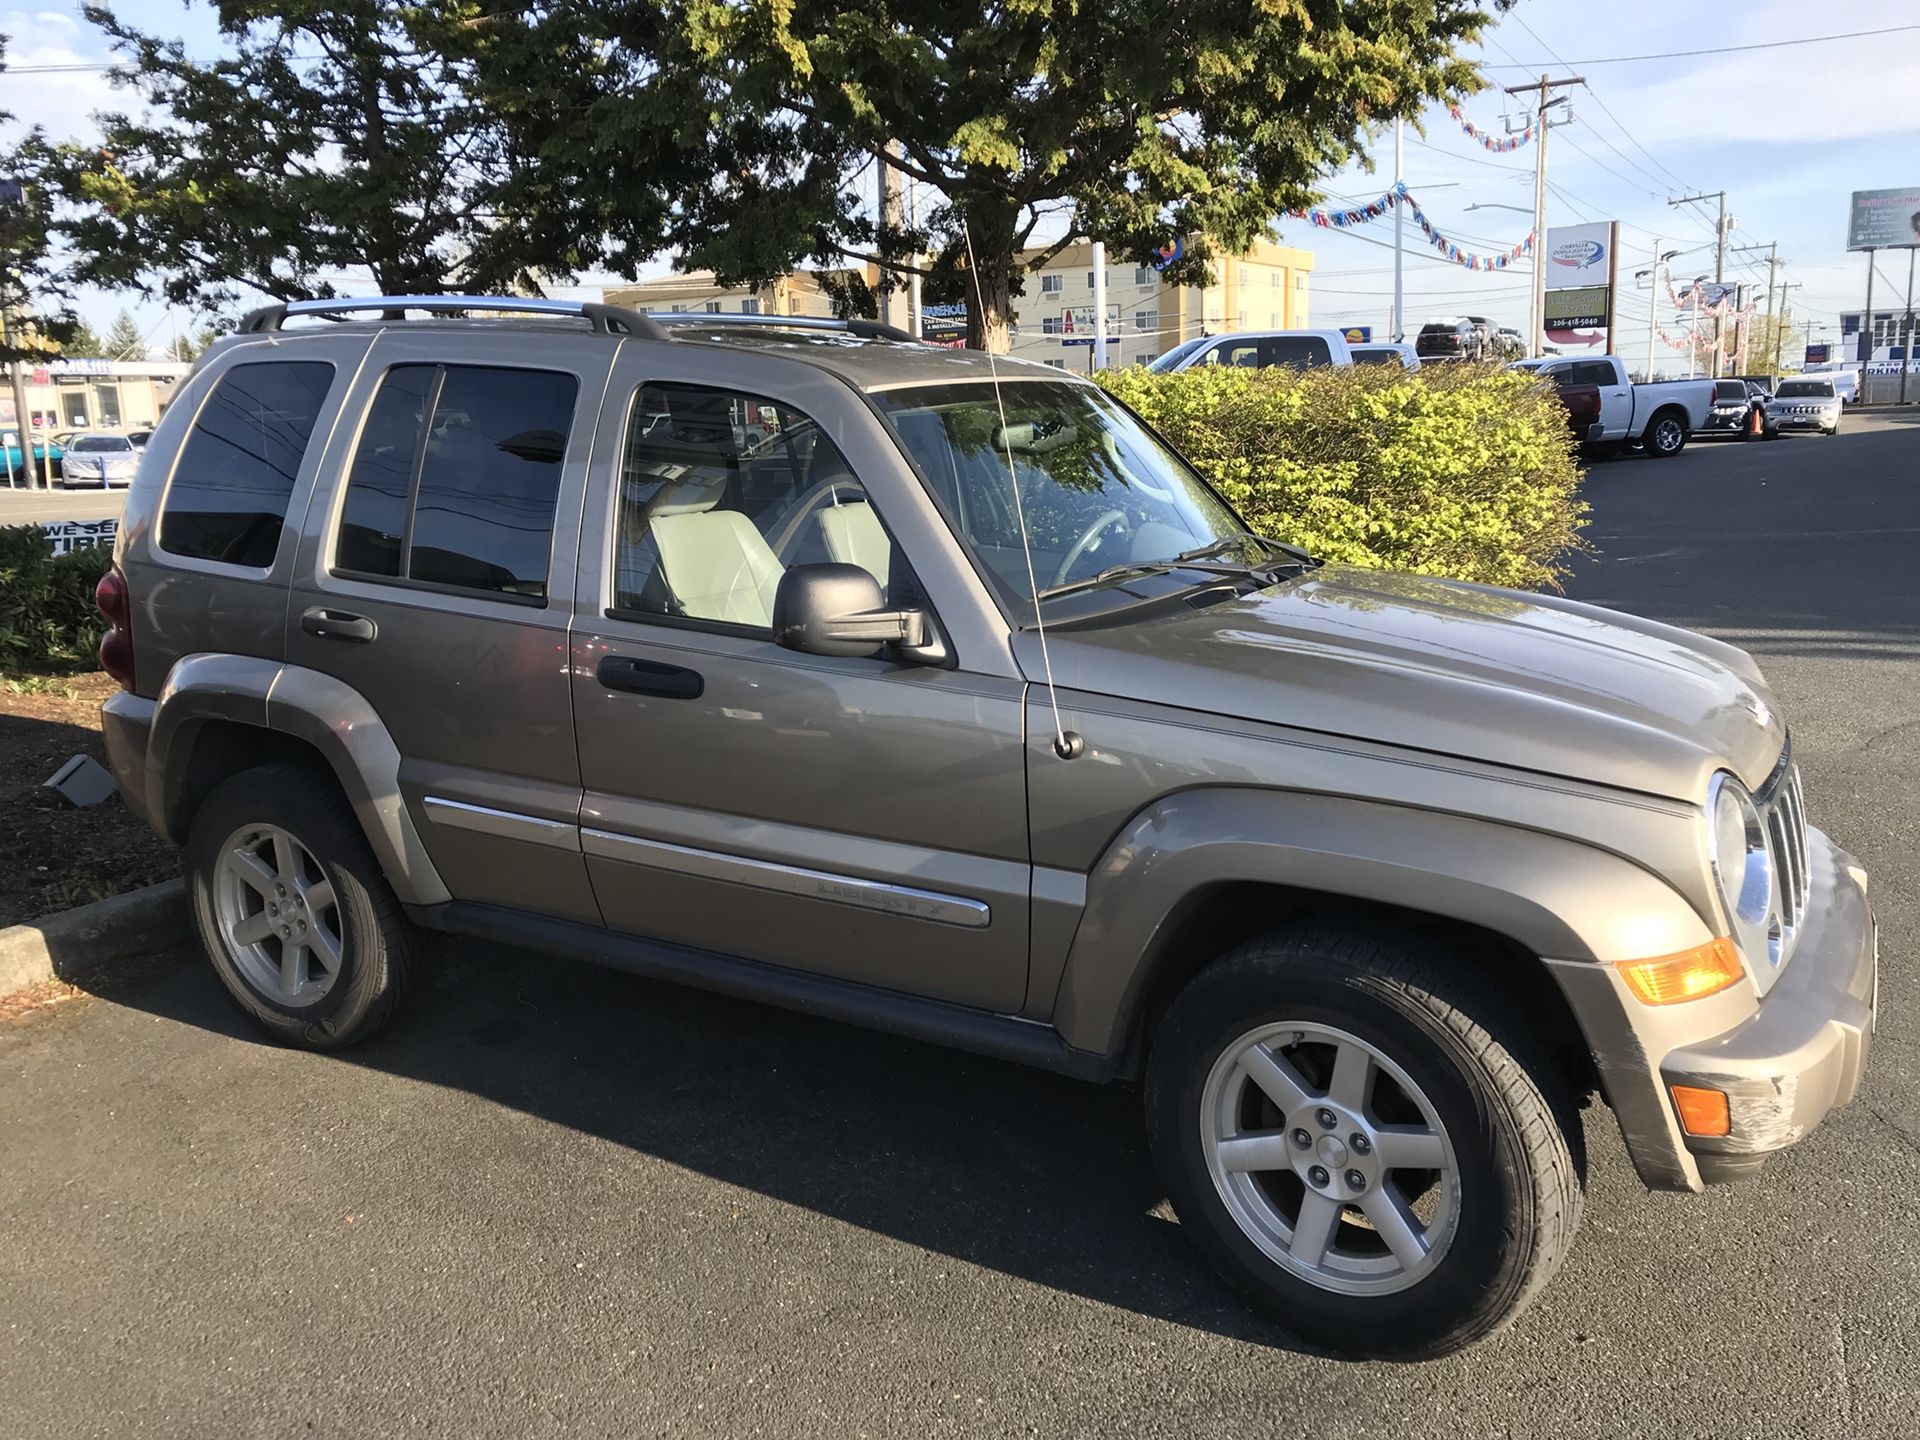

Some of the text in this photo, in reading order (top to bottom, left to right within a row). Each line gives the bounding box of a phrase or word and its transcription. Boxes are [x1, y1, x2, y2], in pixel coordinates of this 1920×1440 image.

[1580, 293, 1603, 302] Center
[1569, 305, 1593, 313] Seattle
[1553, 318, 1598, 327] 206-418-5040
[43, 525, 77, 536] WE
